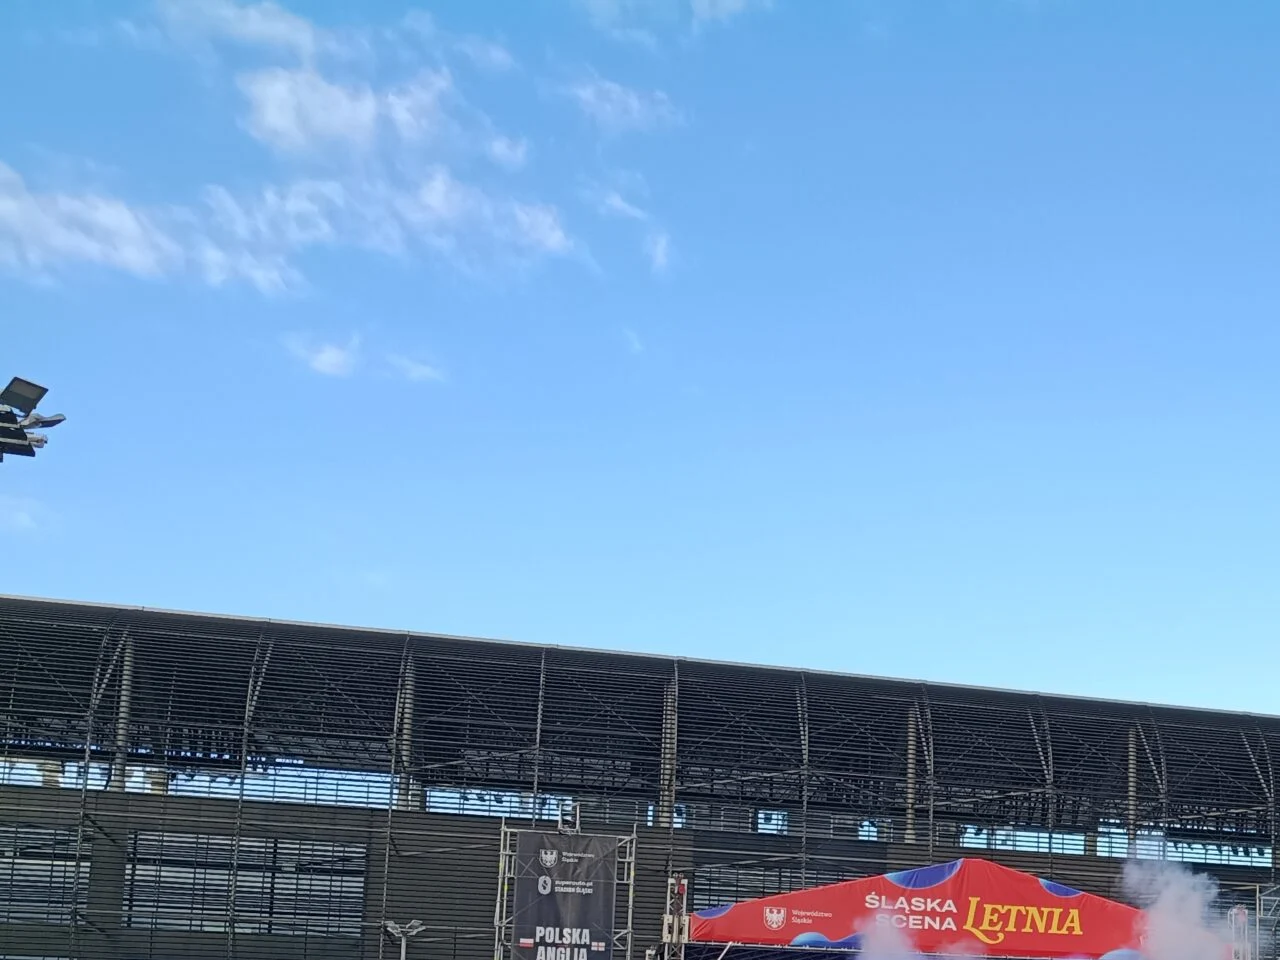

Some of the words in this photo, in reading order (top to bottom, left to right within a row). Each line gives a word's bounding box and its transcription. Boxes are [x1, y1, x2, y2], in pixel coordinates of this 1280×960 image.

[864, 891, 958, 914] ŚLĄSKA
[791, 909, 833, 918] Województwo
[791, 916, 813, 925] Śląskie
[875, 913, 957, 931] SCENA
[962, 896, 1083, 945] LETNIA
[535, 926, 590, 945] POLSKA
